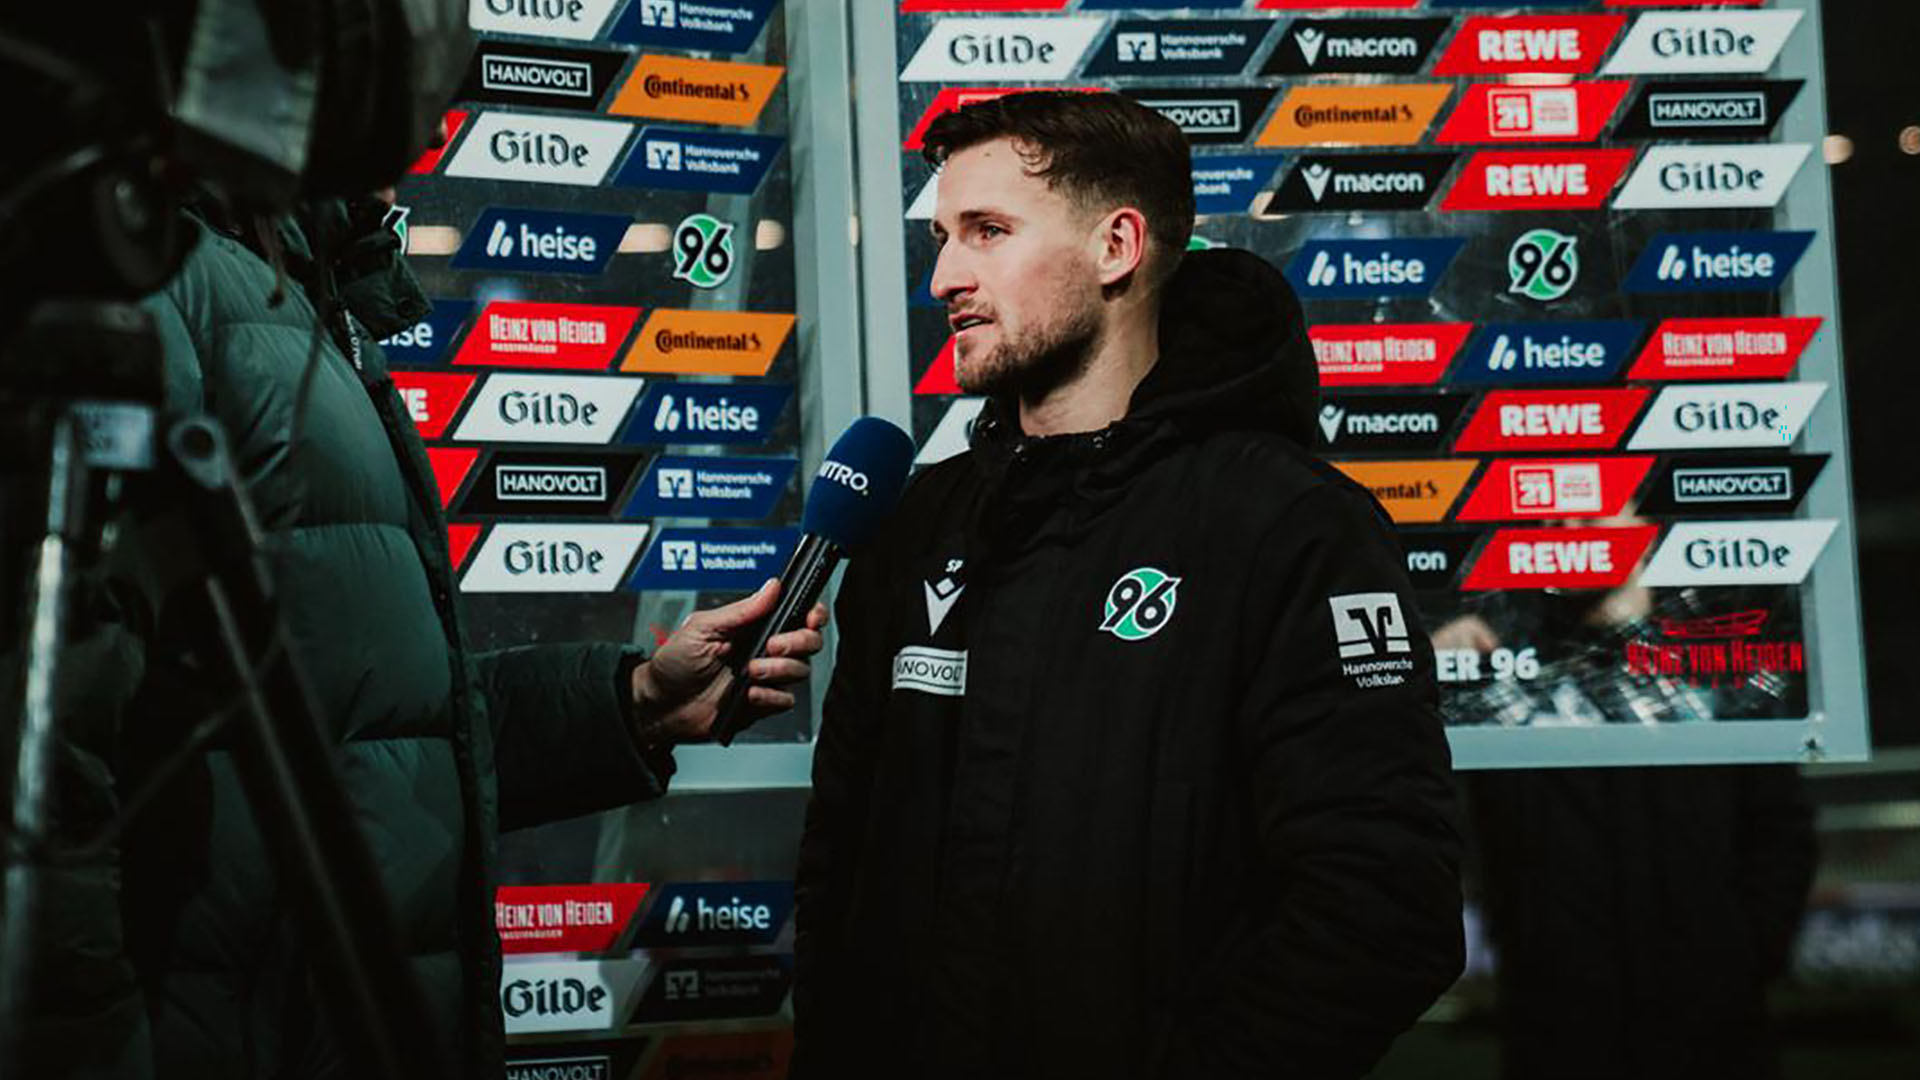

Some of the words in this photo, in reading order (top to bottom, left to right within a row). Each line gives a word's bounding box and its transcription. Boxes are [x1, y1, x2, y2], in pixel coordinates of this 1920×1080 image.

[680, 17, 734, 33] Volksbank
[949, 34, 1054, 65] Gilde
[1161, 33, 1247, 47] Hannoversche
[1161, 47, 1224, 61] Volksbank
[1326, 35, 1418, 59] macron
[1478, 29, 1581, 62] REWE
[1652, 27, 1755, 57] Gilde
[488, 62, 584, 88] HANOVOLT
[643, 74, 737, 99] Continental
[1293, 103, 1398, 127] Continental
[1655, 100, 1759, 119] HANOVOLT
[490, 130, 589, 167] Gilde
[684, 143, 760, 162] Hannoversche
[684, 158, 740, 175] Volksbank
[1485, 164, 1589, 197] REWE
[1660, 163, 1764, 192] Gilde
[1334, 171, 1425, 194] macron
[520, 222, 597, 261] heise
[672, 217, 733, 282] 96
[1343, 251, 1426, 285] heise
[1510, 235, 1577, 294] 96
[1692, 246, 1775, 279] heise
[490, 314, 529, 341] HEINZ
[530, 318, 557, 342] VON
[558, 317, 607, 344] HEIDEN
[655, 329, 748, 353] Continental
[1734, 330, 1787, 355] HEIDEN
[1384, 336, 1436, 362] HEIDEN
[1523, 335, 1606, 368] heise
[499, 390, 599, 427] Gilde
[685, 395, 760, 430] heise
[1346, 411, 1439, 435] macron
[1499, 403, 1604, 437] REWE
[1674, 401, 1779, 432] Gilde
[502, 472, 599, 494] HANOVOLT
[695, 484, 753, 500] Volksbank
[696, 470, 773, 486] Hannoversche
[1680, 475, 1784, 494] HANOVOLT
[504, 540, 604, 575] Gilde
[700, 541, 777, 557] Hannoversche
[700, 555, 758, 571] Volksbank
[1407, 551, 1447, 572] ron
[1508, 540, 1614, 574] REWE
[1685, 538, 1790, 569] Gilde
[1099, 570, 1181, 636] 96
[1434, 648, 1481, 682] ER
[1490, 647, 1541, 681] 96
[495, 902, 535, 929] HEINZ
[536, 904, 563, 928] VON
[565, 900, 614, 926] HEIDEN
[696, 896, 771, 931] heise
[503, 979, 606, 1017] Gilde
